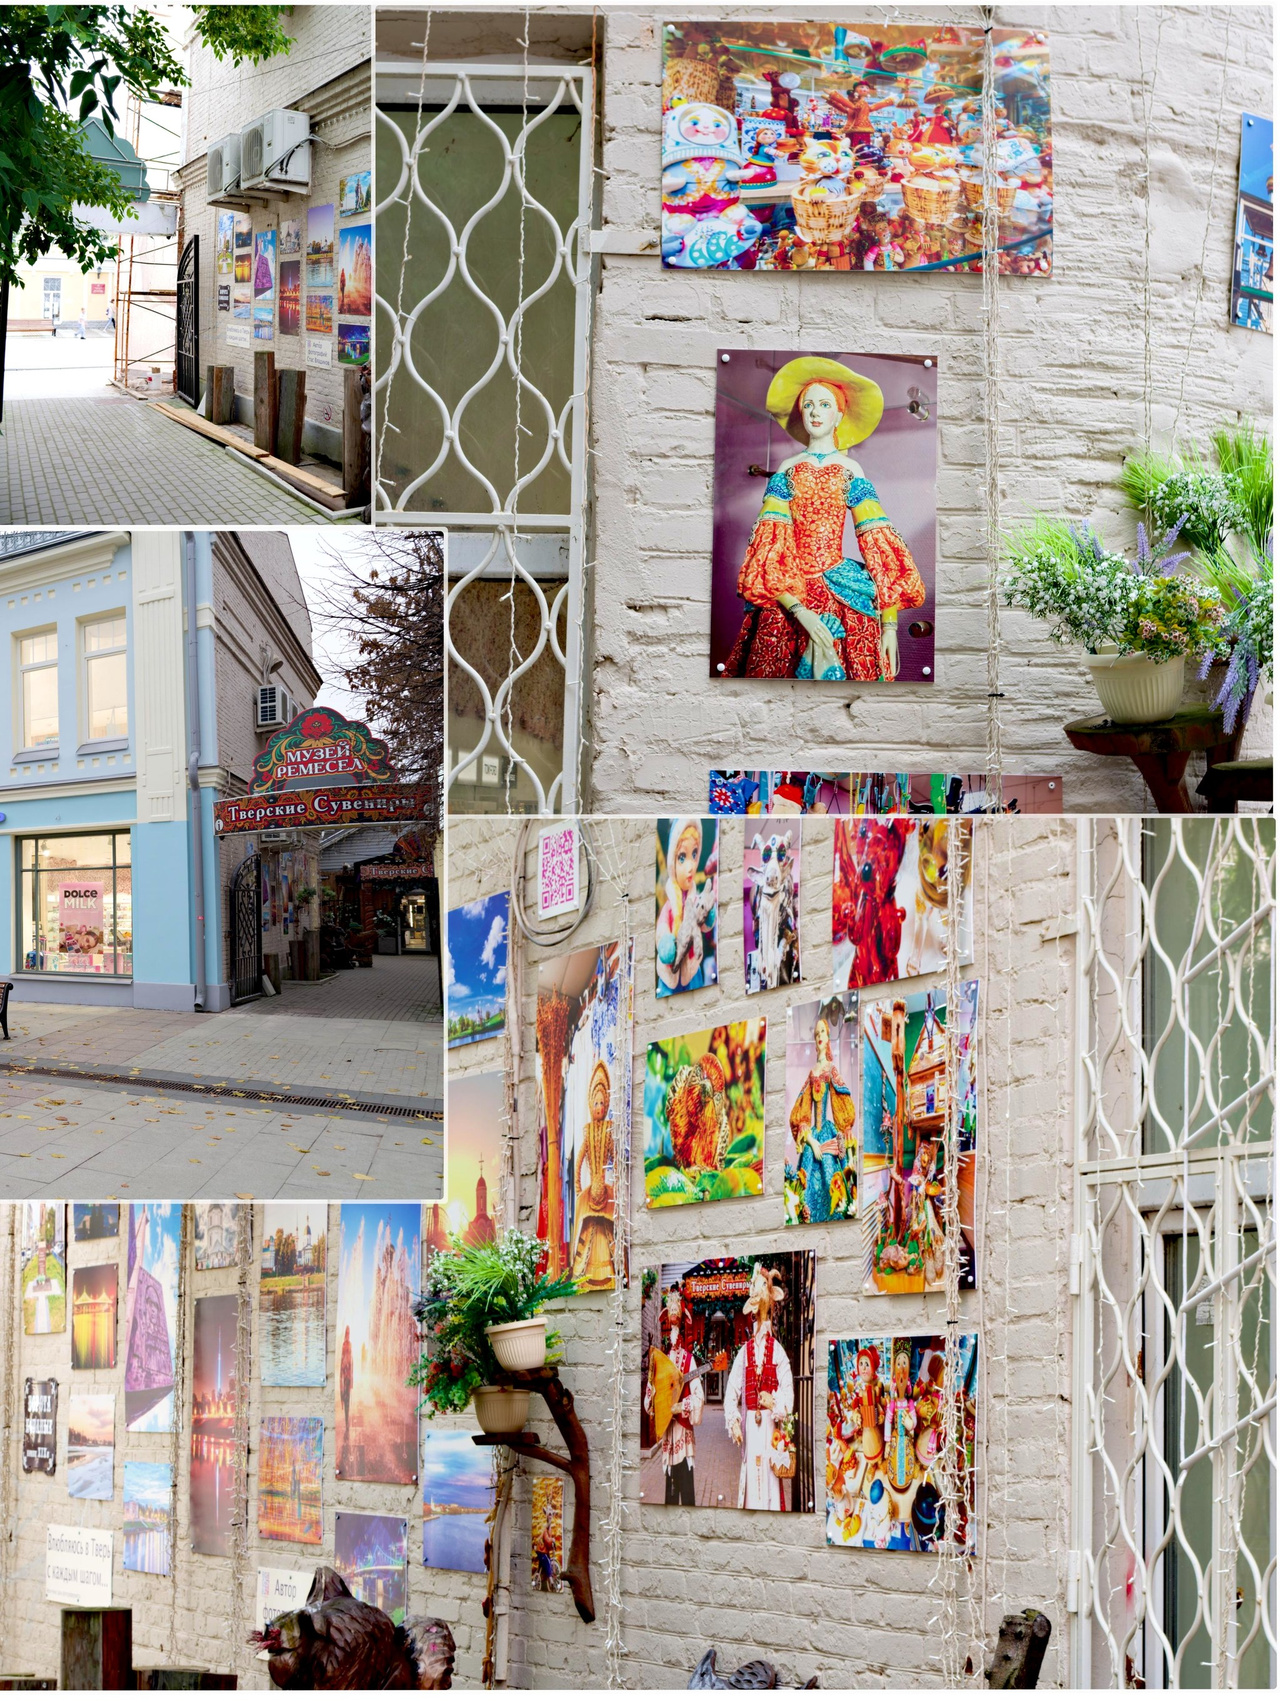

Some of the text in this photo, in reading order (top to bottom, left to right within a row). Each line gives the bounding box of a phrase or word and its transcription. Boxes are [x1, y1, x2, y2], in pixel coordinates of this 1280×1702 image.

[286, 741, 351, 763] МУЗЕЙ
[277, 760, 363, 778] РЕМЕСЕЛ
[228, 796, 415, 823] Тверские Сувениры
[370, 867, 417, 876] Тверские
[64, 898, 97, 909] MILK
[691, 1281, 719, 1294] Тверские
[91, 1538, 111, 1562] Тверь
[275, 1579, 296, 1602] Автор
